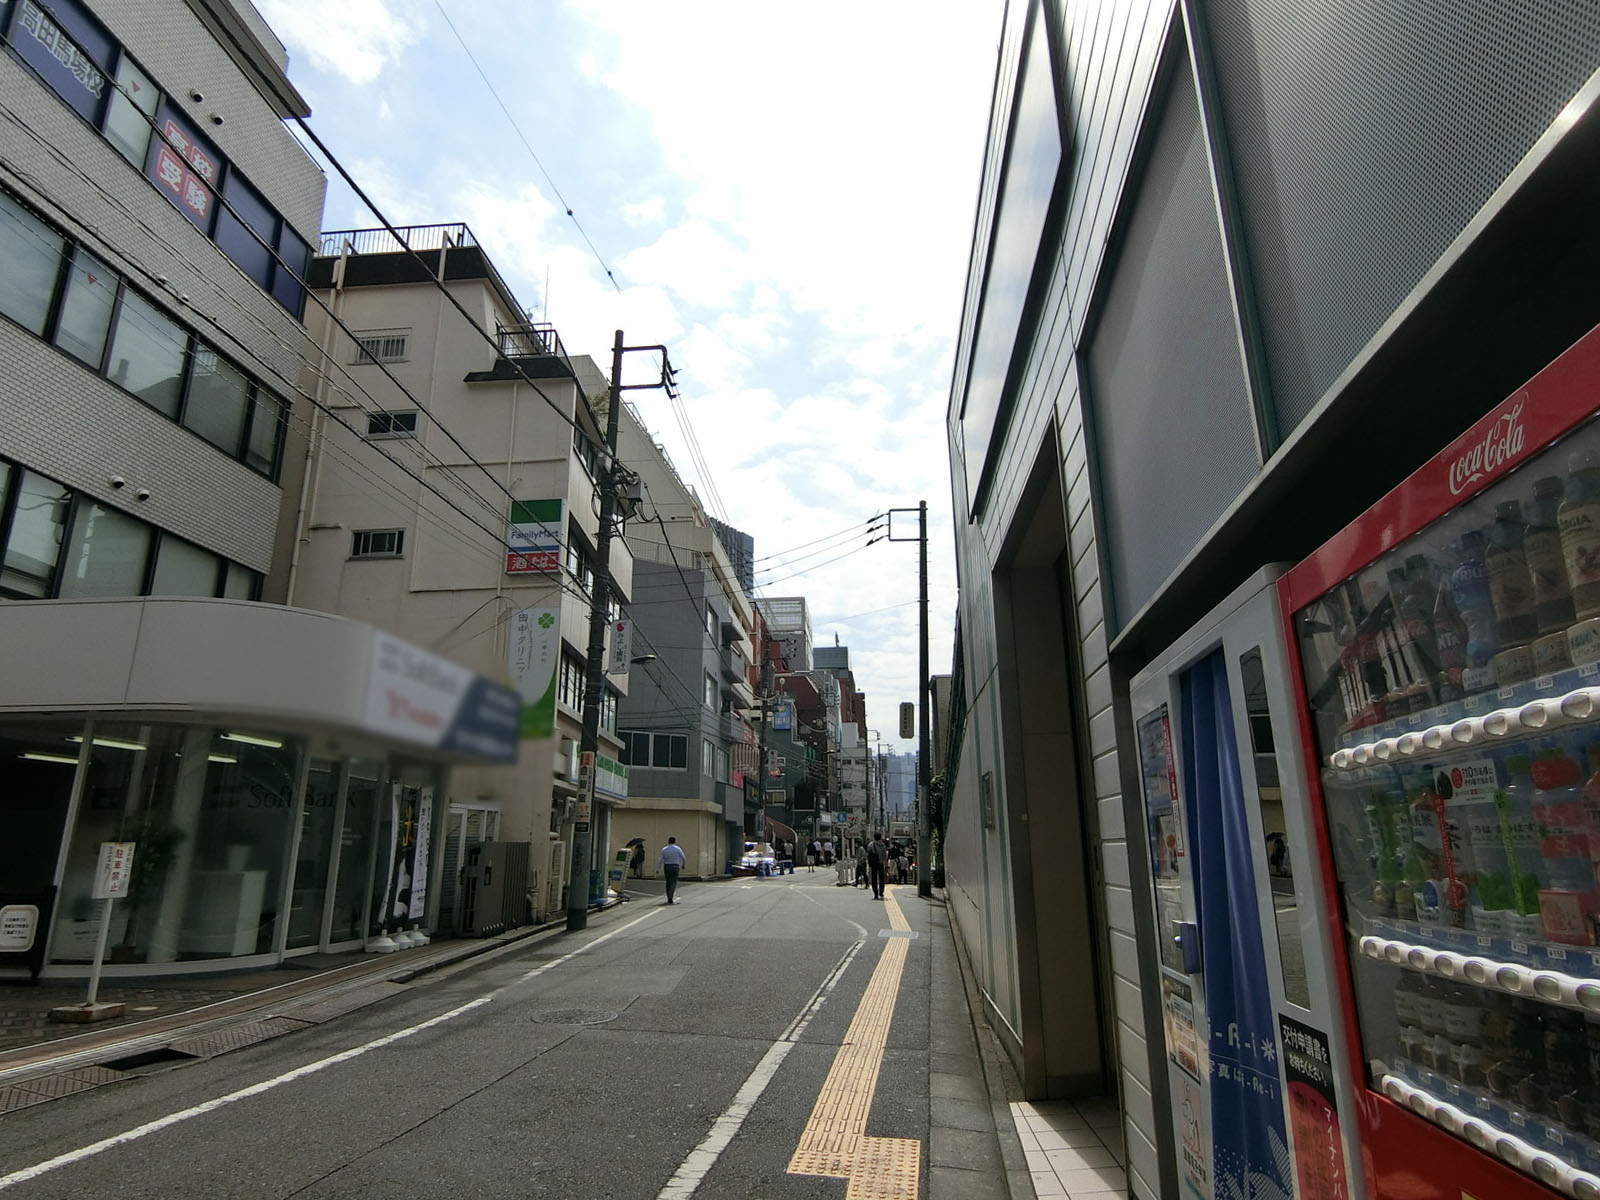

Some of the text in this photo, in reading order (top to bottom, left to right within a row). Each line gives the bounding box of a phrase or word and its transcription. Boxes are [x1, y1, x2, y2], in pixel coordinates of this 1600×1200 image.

[18, 0, 105, 99] 高田馬場校
[160, 156, 208, 216] 受験
[1449, 398, 1525, 496] Coca-Cola
[511, 529, 559, 541] FamilyMart
[515, 613, 528, 680] 田中クリニッ
[109, 848, 124, 893] 駐車禁止
[1282, 1024, 1329, 1064] 交付申請書を
